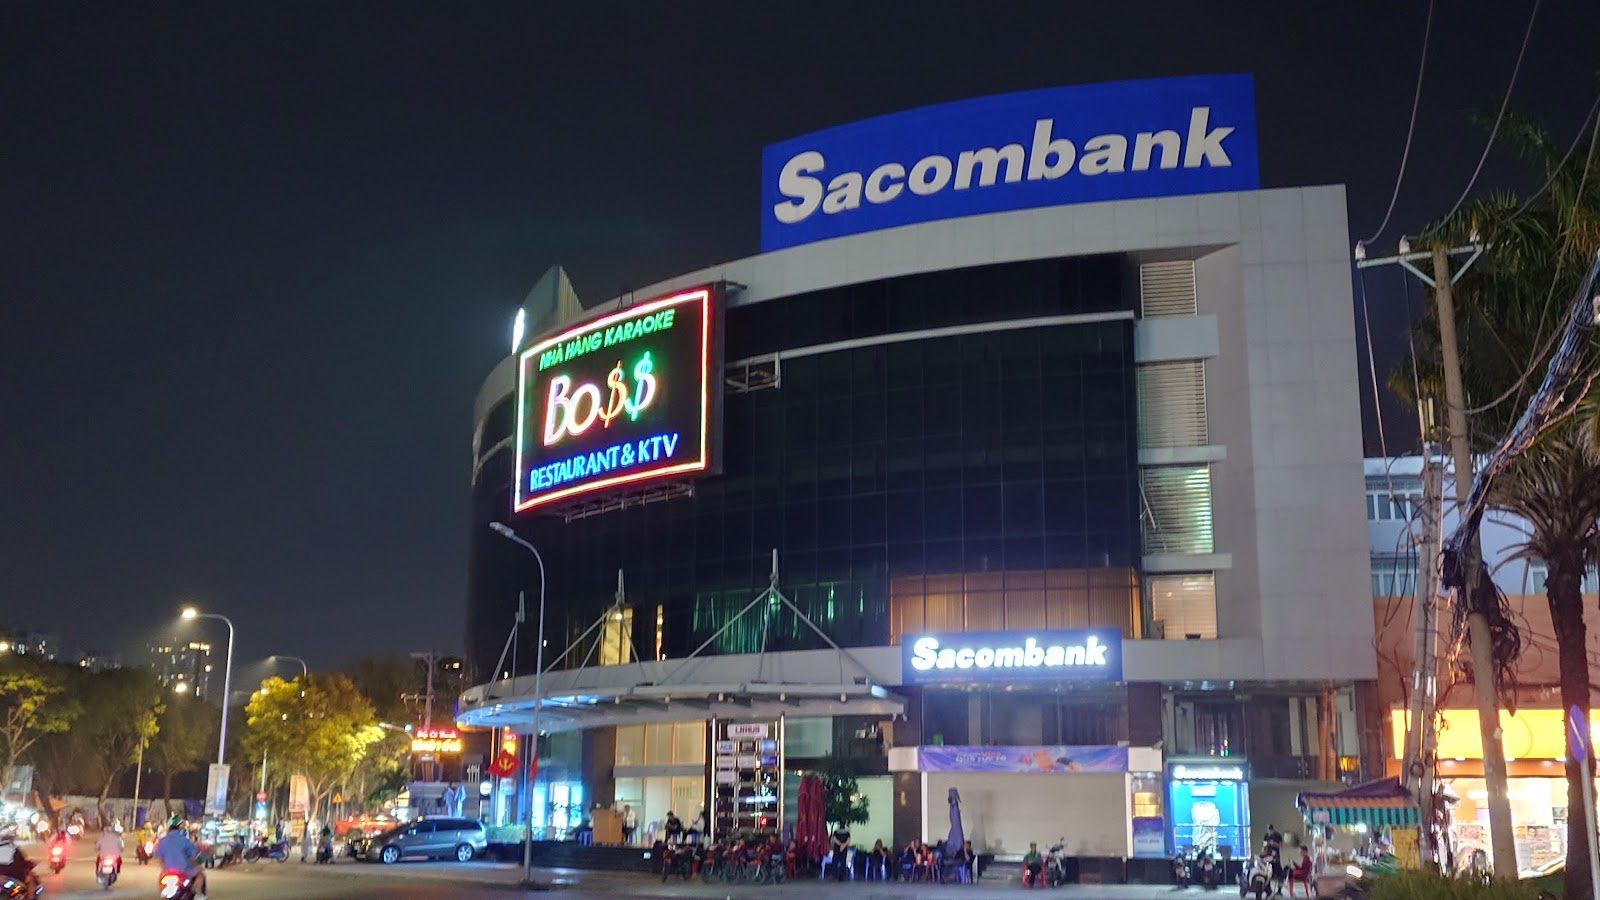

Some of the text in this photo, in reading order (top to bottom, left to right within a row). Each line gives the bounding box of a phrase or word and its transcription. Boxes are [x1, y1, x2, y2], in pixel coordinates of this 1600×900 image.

[774, 106, 1235, 225] Sacombank
[540, 309, 675, 370] NHÀ HÀNG KARAOKE
[638, 432, 679, 464] KTV
[910, 633, 1108, 671] Sacombank
